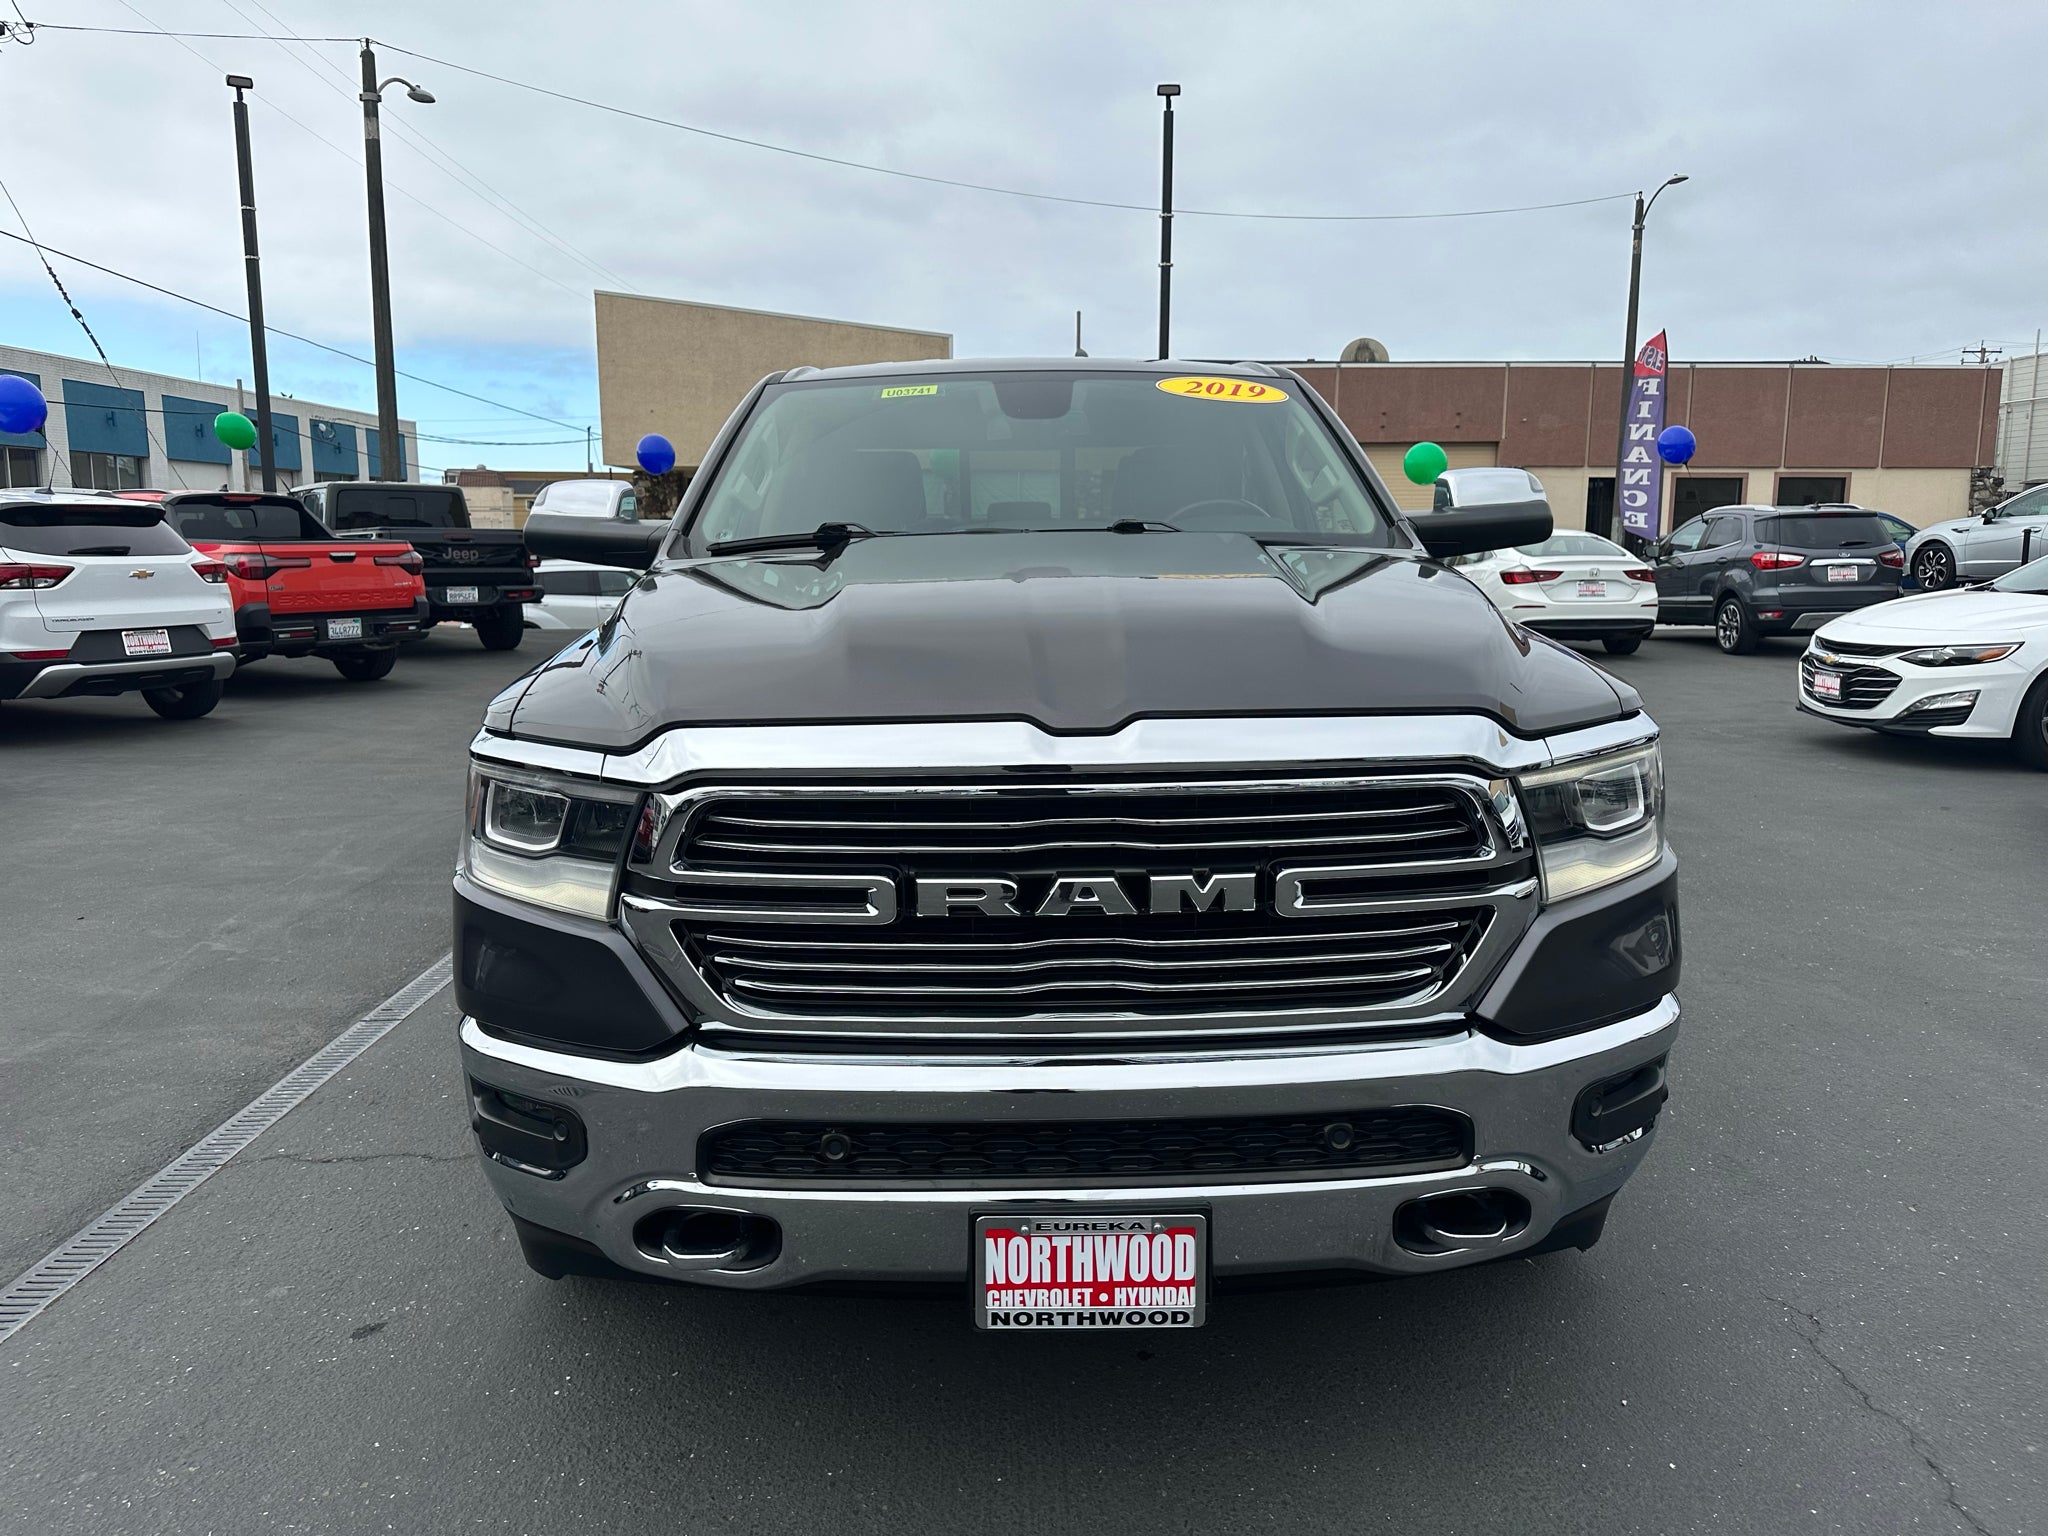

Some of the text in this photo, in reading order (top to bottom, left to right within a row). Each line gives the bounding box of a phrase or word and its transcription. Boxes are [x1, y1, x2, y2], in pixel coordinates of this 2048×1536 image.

[887, 387, 931, 397] U03741
[1184, 380, 1266, 398] 2019
[442, 547, 479, 561] Jeep
[915, 872, 1257, 917] RAM
[1035, 1222, 1146, 1232] EUREKA
[985, 1233, 1195, 1285] NORTHWOOD
[986, 1288, 1093, 1307] CHEVROLET
[990, 1311, 1191, 1326] NORTHWOOD
